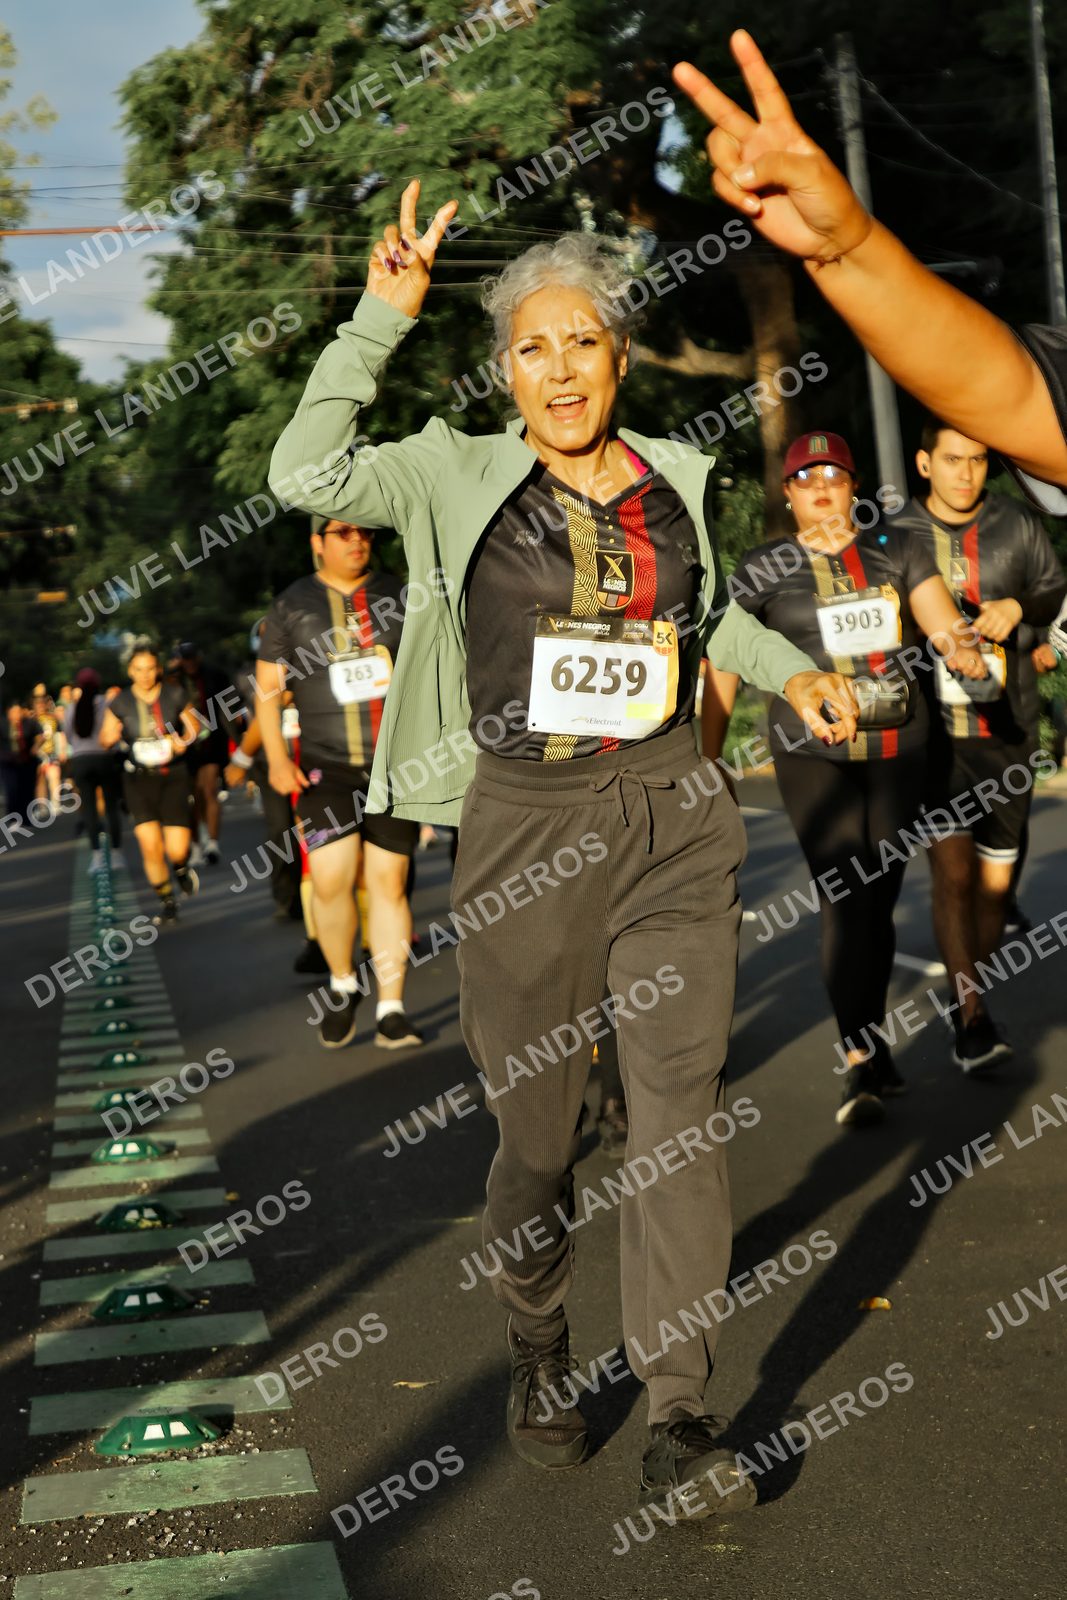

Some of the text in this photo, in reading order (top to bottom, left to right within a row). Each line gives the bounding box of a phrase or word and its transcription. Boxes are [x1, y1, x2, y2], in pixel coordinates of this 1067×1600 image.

[832, 608, 883, 634] 3903
[656, 632, 673, 645] 5K
[344, 664, 374, 683] 263
[551, 654, 647, 697] 6259
